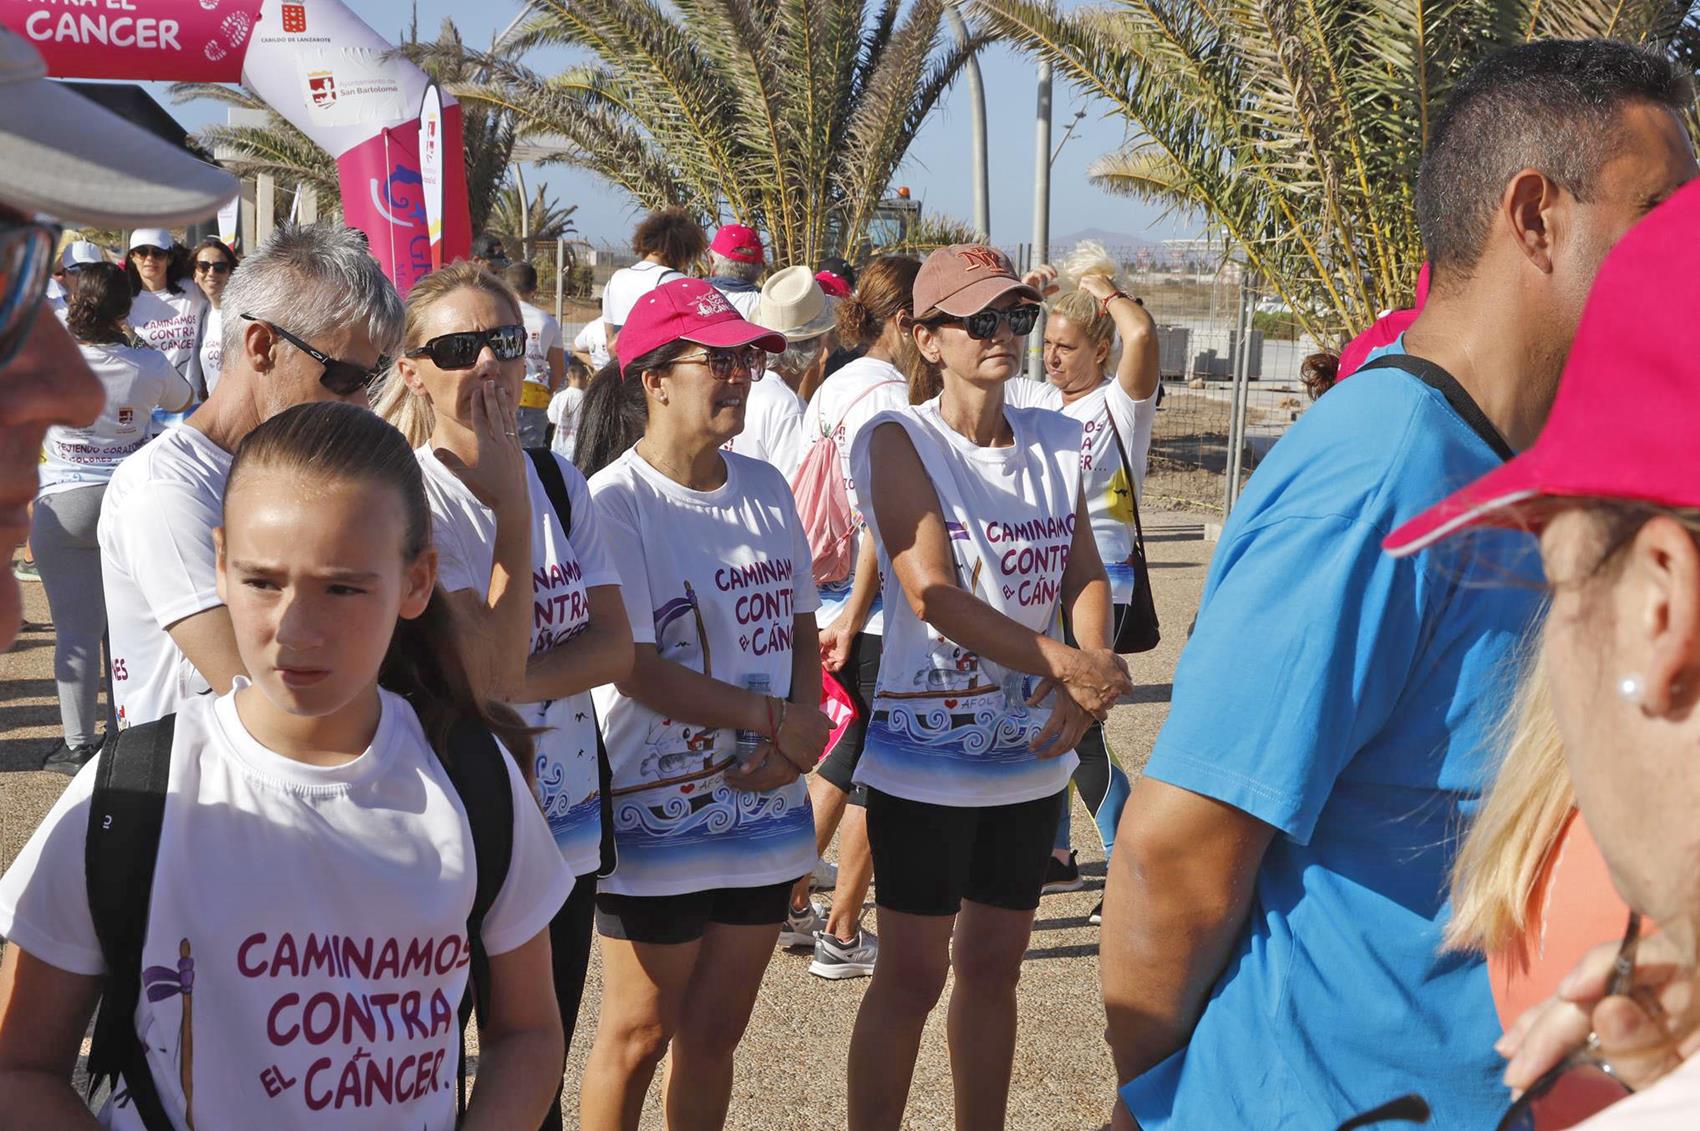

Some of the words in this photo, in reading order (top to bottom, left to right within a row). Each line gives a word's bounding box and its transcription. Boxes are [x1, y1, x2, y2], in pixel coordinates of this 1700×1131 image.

[25, 10, 182, 50] CANCER
[340, 88, 356, 97] San
[143, 315, 196, 330] CAMINAMOS
[149, 326, 195, 341] CONTRA
[1002, 584, 1015, 600] EL
[1018, 574, 1060, 606] CÁN
[738, 634, 750, 652] EL
[752, 620, 794, 656] CÁN
[237, 932, 471, 980] CAMINAMOS
[267, 987, 452, 1046] CONTRA
[259, 1065, 297, 1098] EL
